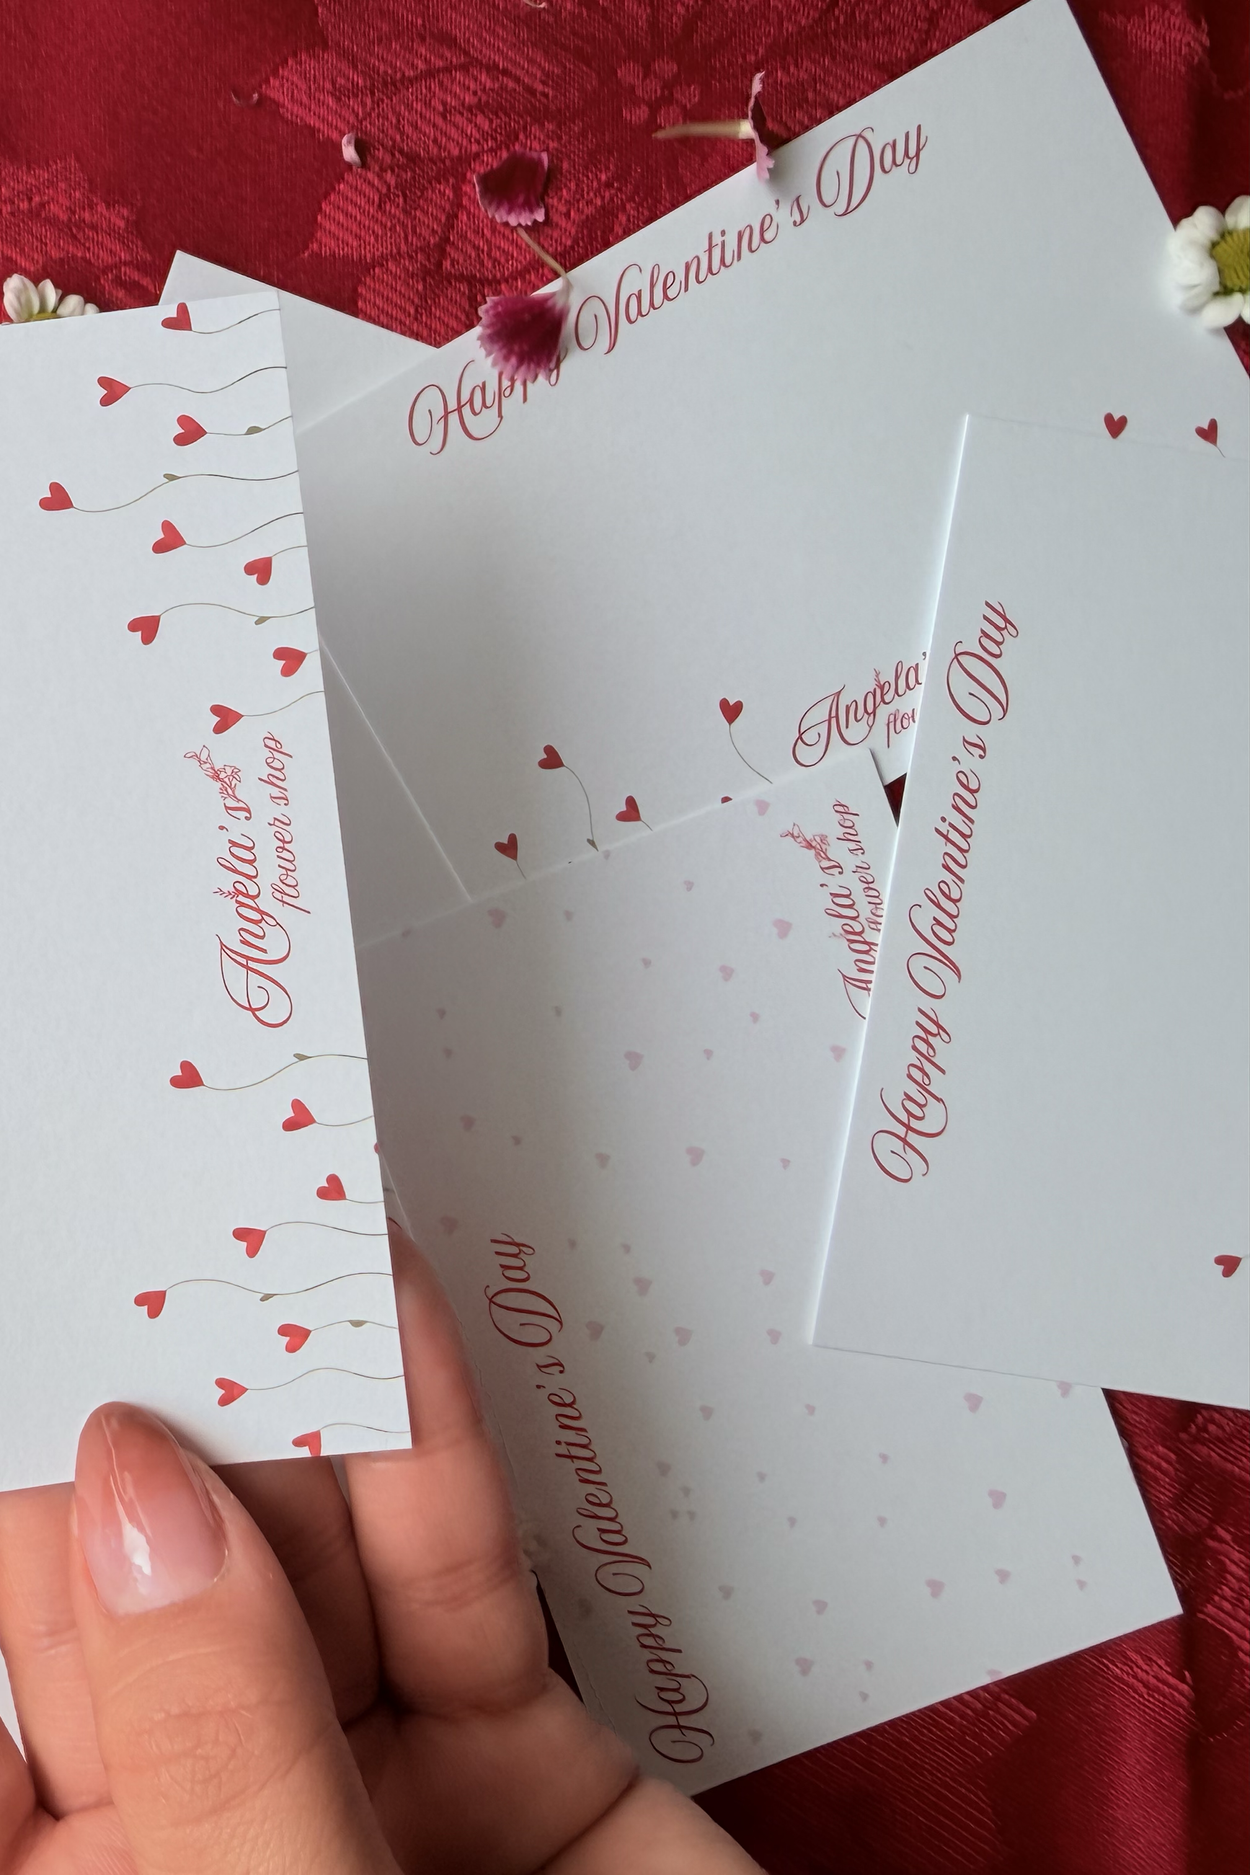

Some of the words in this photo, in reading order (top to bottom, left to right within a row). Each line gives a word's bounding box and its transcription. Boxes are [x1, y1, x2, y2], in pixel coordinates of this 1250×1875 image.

[574, 191, 811, 355] Valentine's
[815, 123, 928, 217] Day
[791, 651, 927, 768] Angela'
[946, 600, 1019, 726] Day
[258, 731, 293, 807] shop
[832, 798, 866, 857] shop
[215, 799, 294, 1029] Angela's
[267, 812, 311, 914] flower
[906, 733, 987, 1001] Valentine's
[870, 1006, 952, 1184] Happy
[483, 1232, 563, 1351] Day
[534, 1354, 652, 1598] Valentine's
[627, 1604, 715, 1766] Happy
